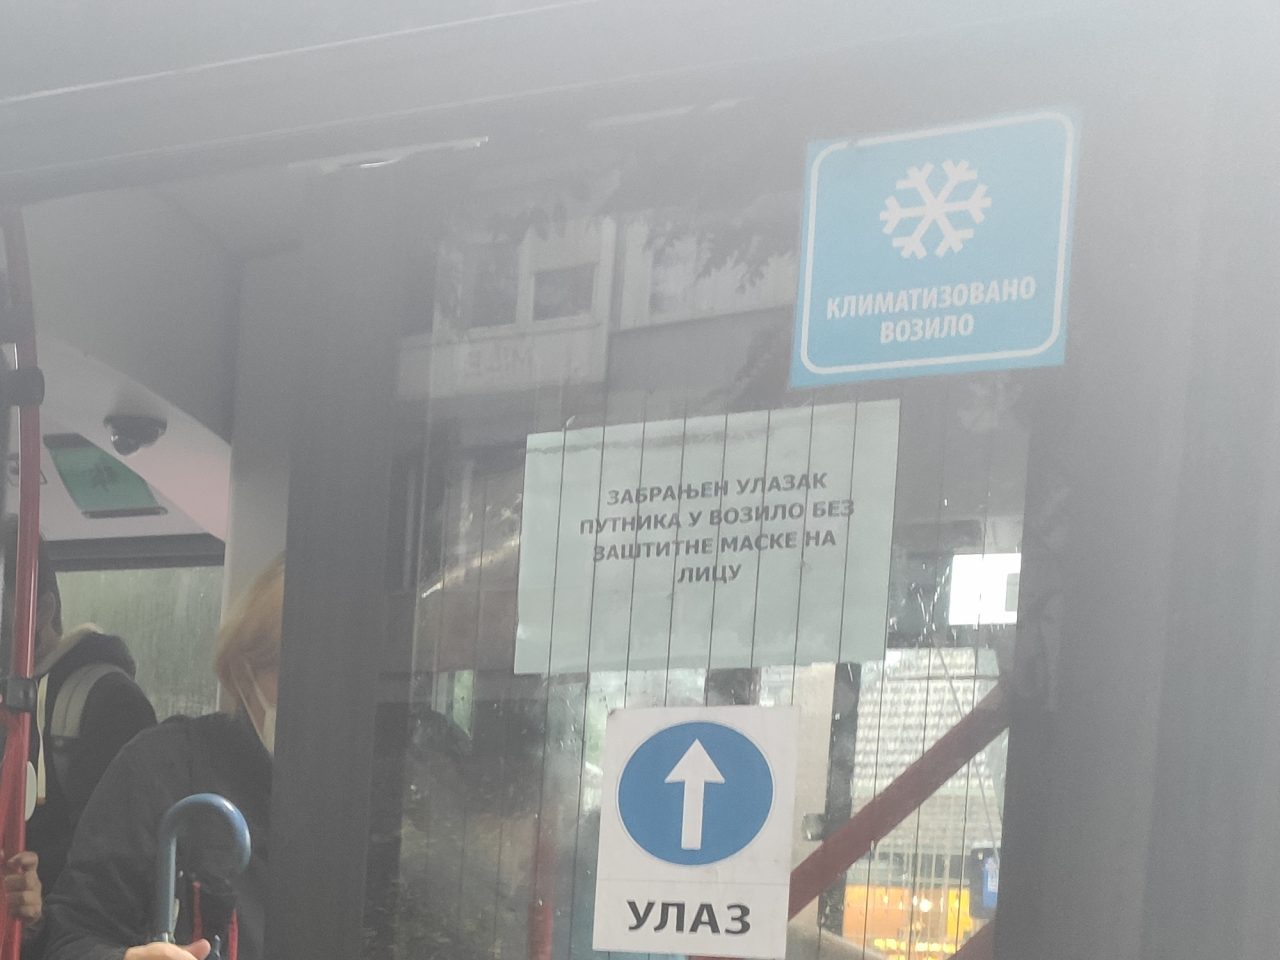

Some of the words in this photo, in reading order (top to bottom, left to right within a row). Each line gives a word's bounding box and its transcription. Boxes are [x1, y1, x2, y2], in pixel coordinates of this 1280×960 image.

[826, 276, 1036, 320] КЛИМАТИЗОВАНО
[880, 313, 974, 344] ВОЗИЛО
[607, 480, 729, 506] ЗАБРАЊЕН
[736, 472, 829, 495] УЛАЗАК
[579, 514, 681, 535] ПУТНИКА
[688, 511, 703, 528] У
[709, 502, 805, 526] ВОЗИЛО
[812, 499, 855, 518] БЕЗ
[593, 537, 713, 562] ЗАШТИТНЕ
[720, 531, 797, 553] МАСКЕ
[805, 529, 836, 547] НА
[677, 564, 742, 584] ЛИЦУ
[626, 900, 751, 936] УЛАЗ
